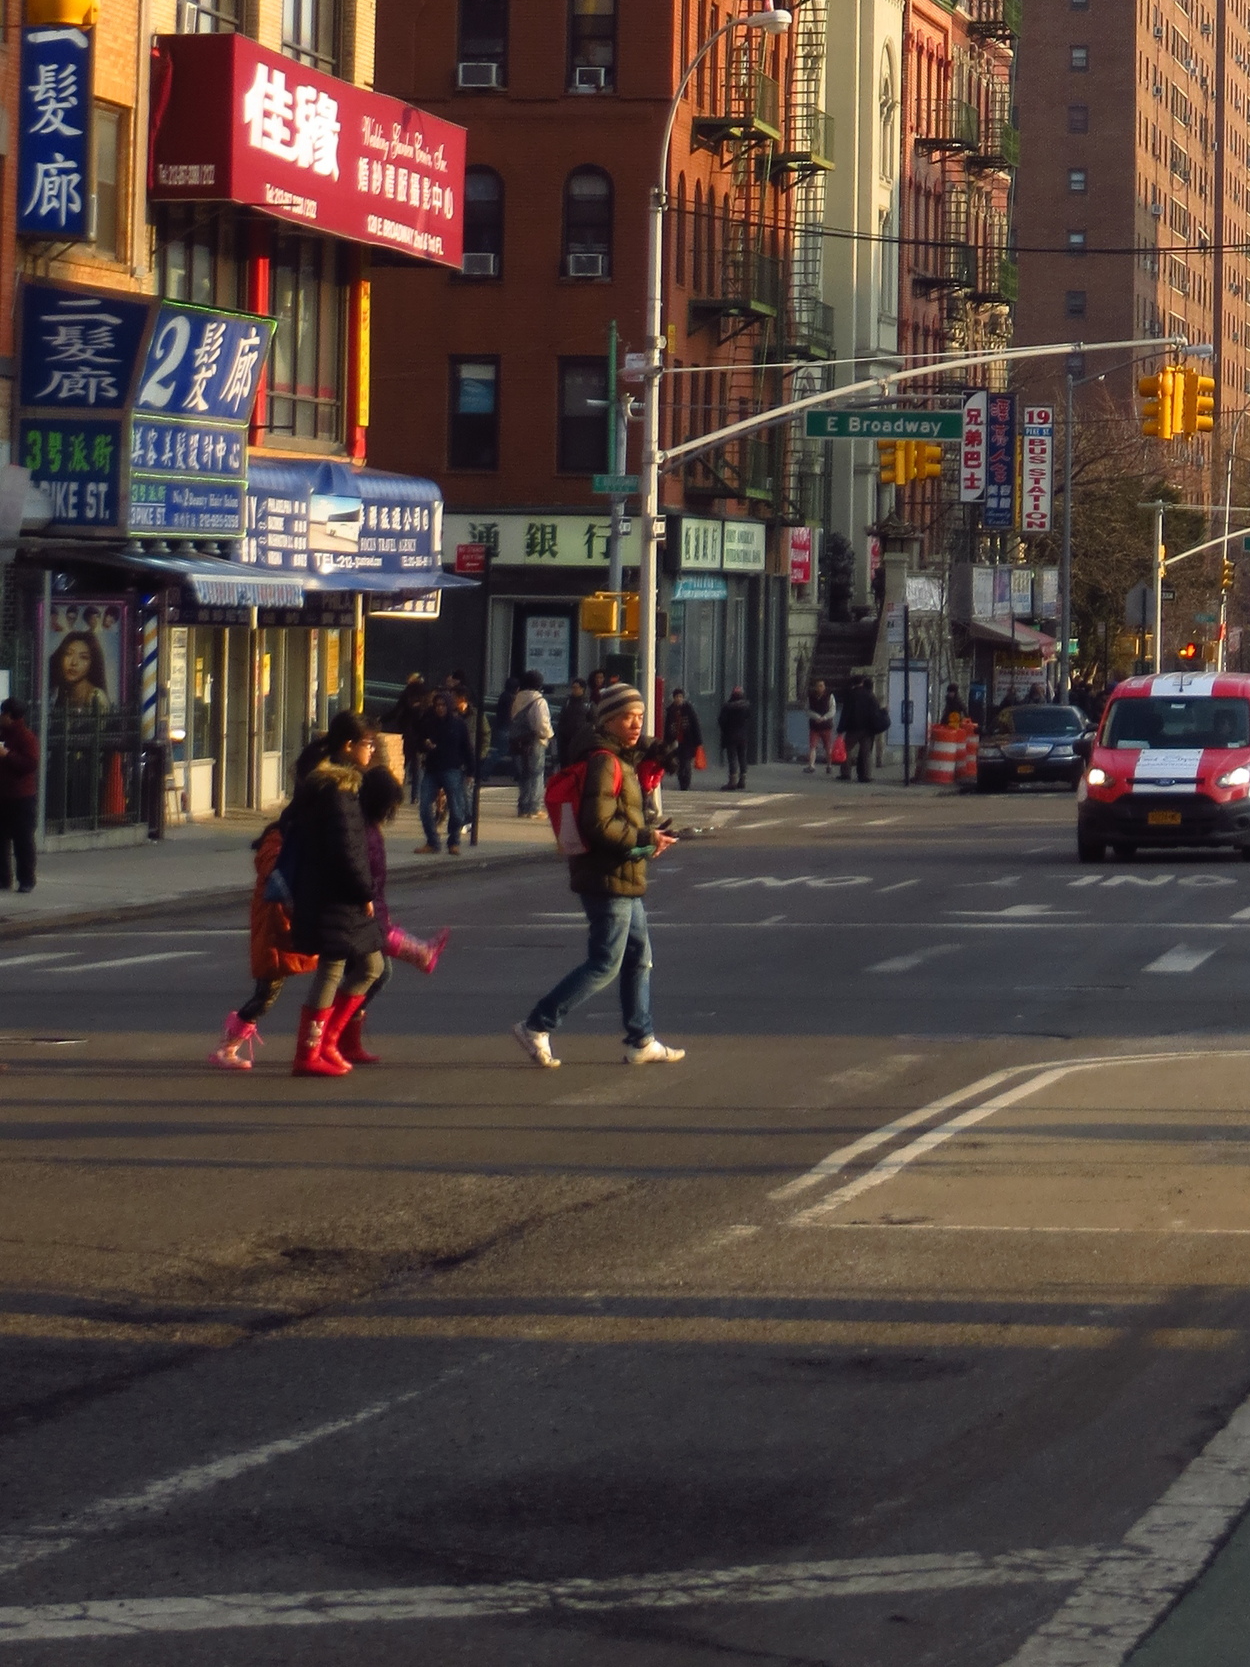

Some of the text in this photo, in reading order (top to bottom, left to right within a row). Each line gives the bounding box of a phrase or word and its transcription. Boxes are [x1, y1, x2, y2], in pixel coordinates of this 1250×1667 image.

[827, 417, 942, 436] E Broadway
[1026, 409, 1050, 425] 19
[963, 408, 983, 490] 兄弟巴士
[1029, 438, 1047, 464] BUS
[1025, 468, 1048, 529] STATION
[136, 507, 154, 525] PIKE
[378, 538, 397, 552] TRAVEL
